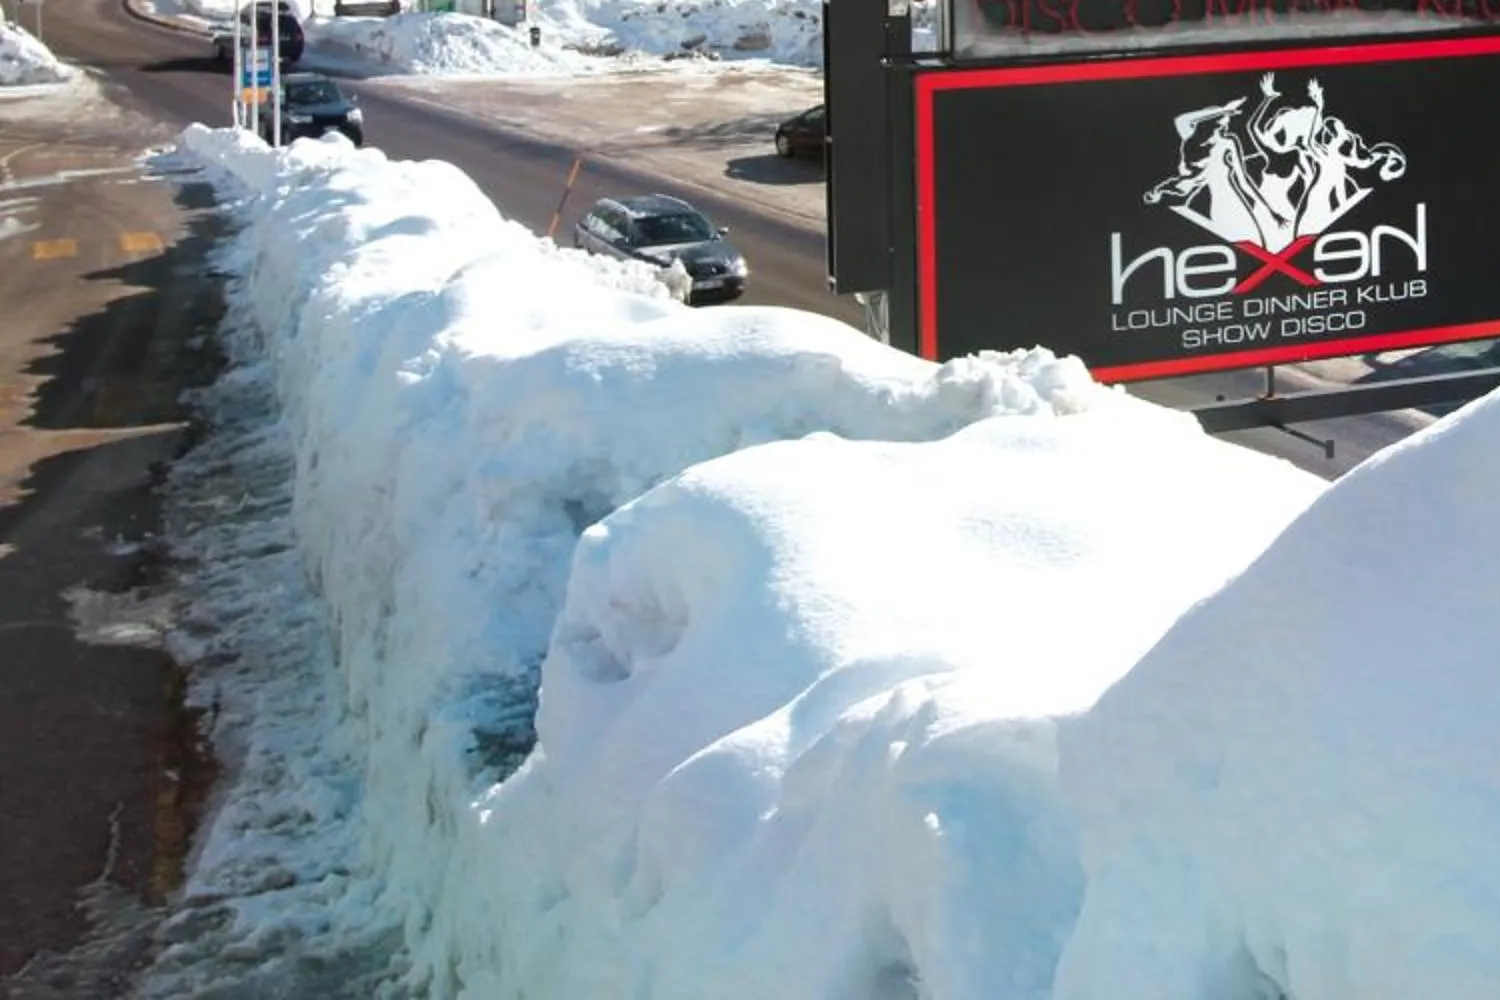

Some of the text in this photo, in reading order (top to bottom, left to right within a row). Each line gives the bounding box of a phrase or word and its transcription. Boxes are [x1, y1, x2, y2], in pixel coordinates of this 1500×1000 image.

[1111, 279, 1427, 331] LOUNGE DINNER KLUB
[1182, 310, 1365, 348] SHOW DISCO
